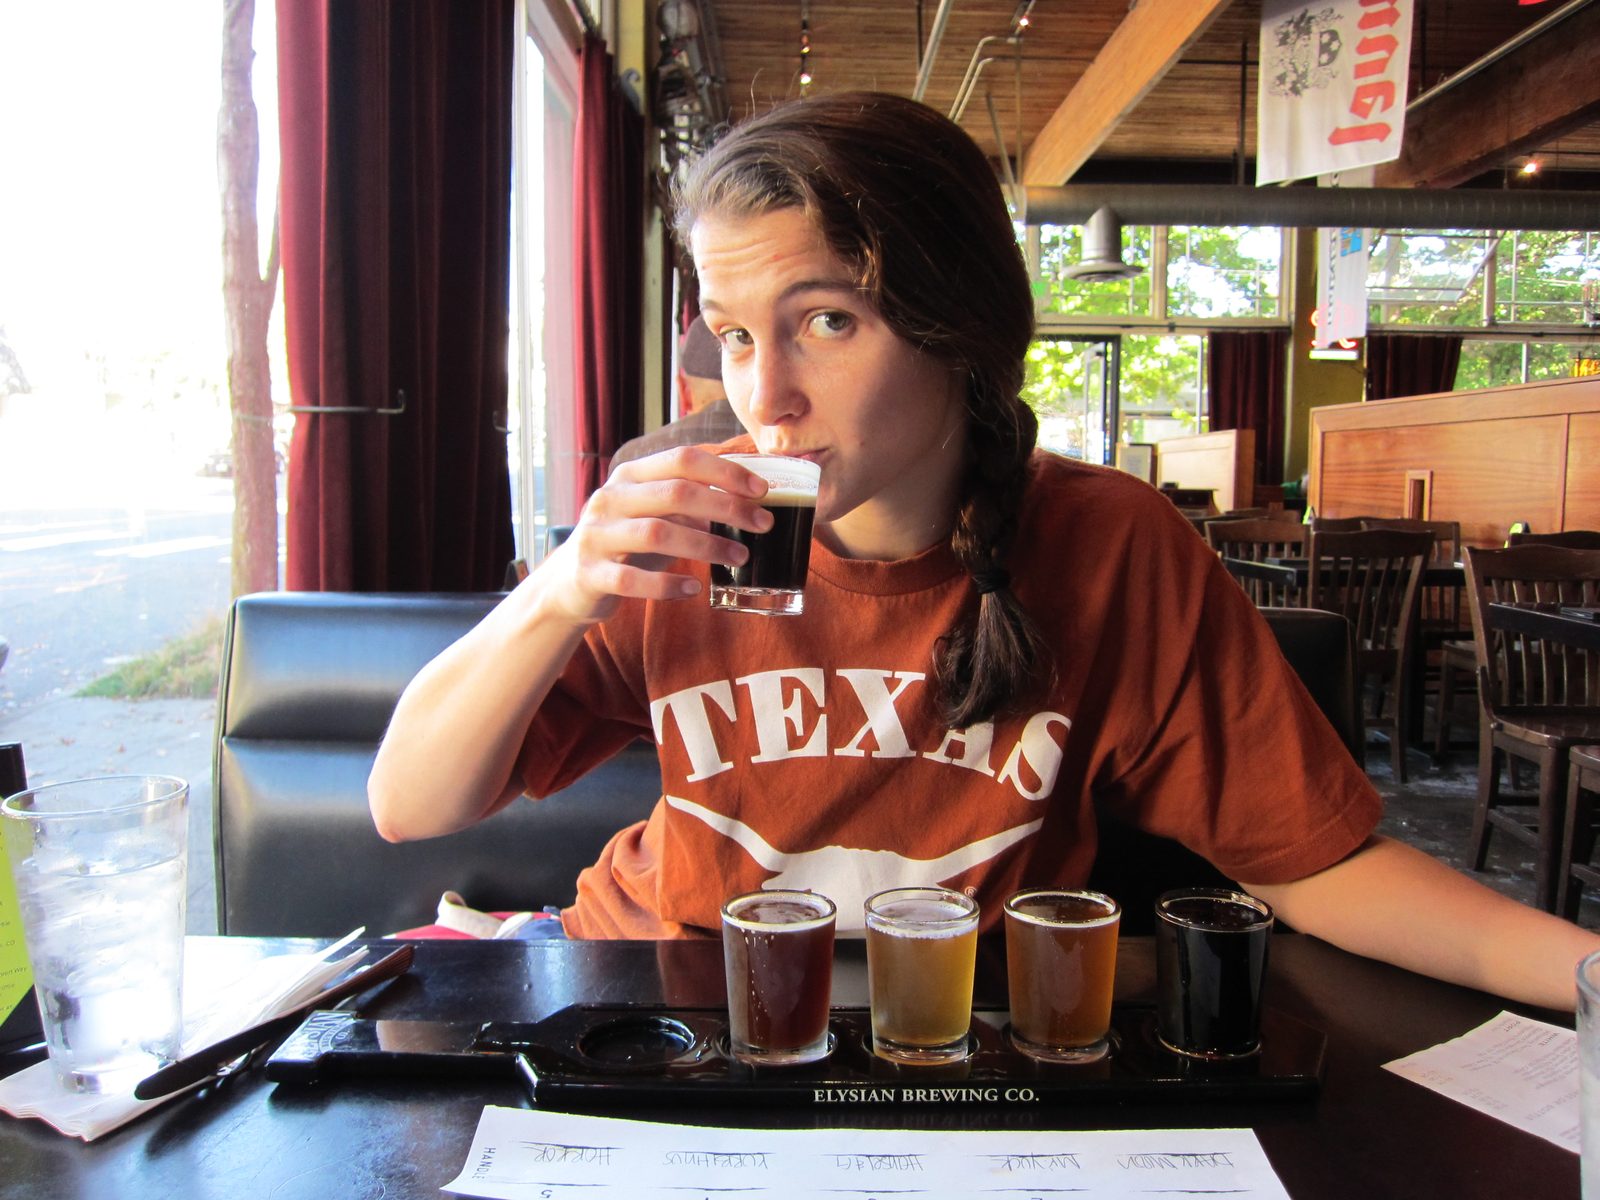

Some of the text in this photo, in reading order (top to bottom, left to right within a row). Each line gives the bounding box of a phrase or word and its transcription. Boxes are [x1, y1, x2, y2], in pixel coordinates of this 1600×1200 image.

[650, 667, 1072, 801] TEXAS
[813, 1088, 1040, 1103] ELYSIAN BREWING CO.
